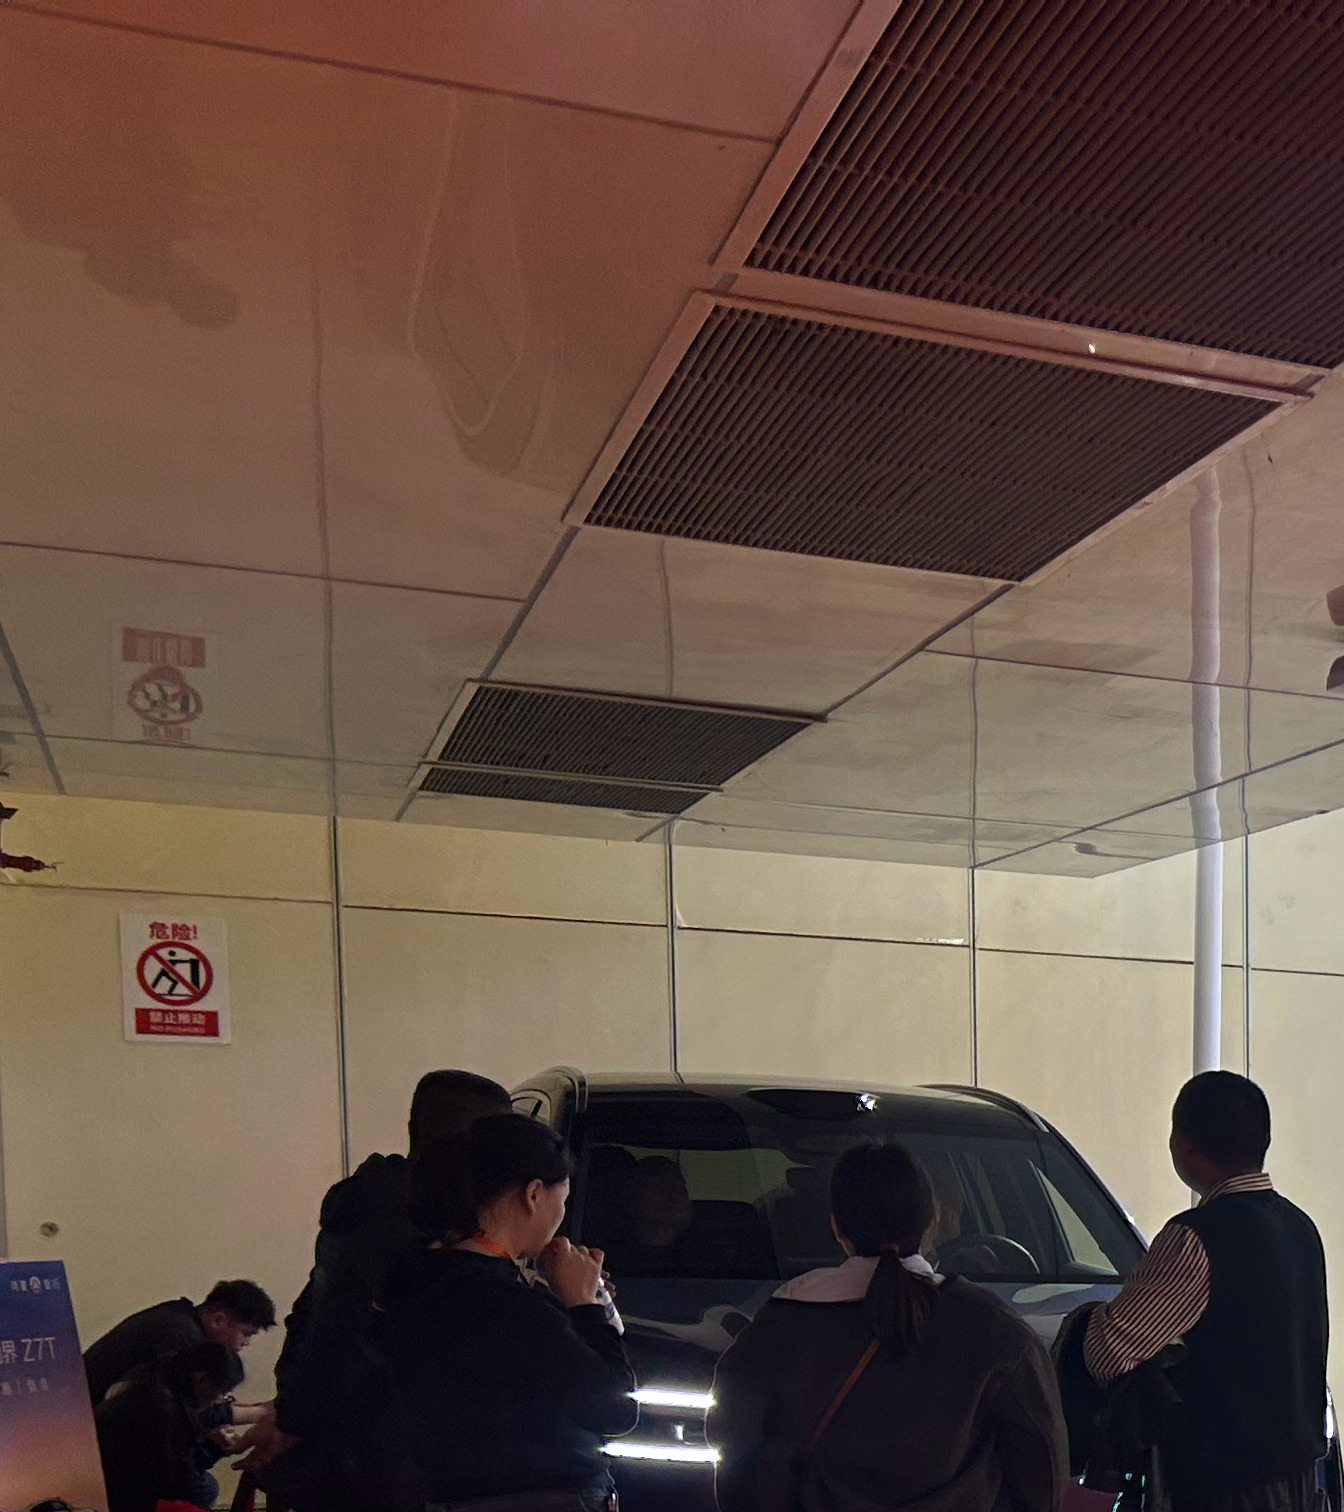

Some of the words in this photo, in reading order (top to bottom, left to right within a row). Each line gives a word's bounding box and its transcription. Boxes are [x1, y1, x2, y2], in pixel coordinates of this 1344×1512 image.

[148, 921, 199, 941] 危险!
[0, 1340, 17, 1365] 界
[21, 1337, 56, 1362] Z7T
